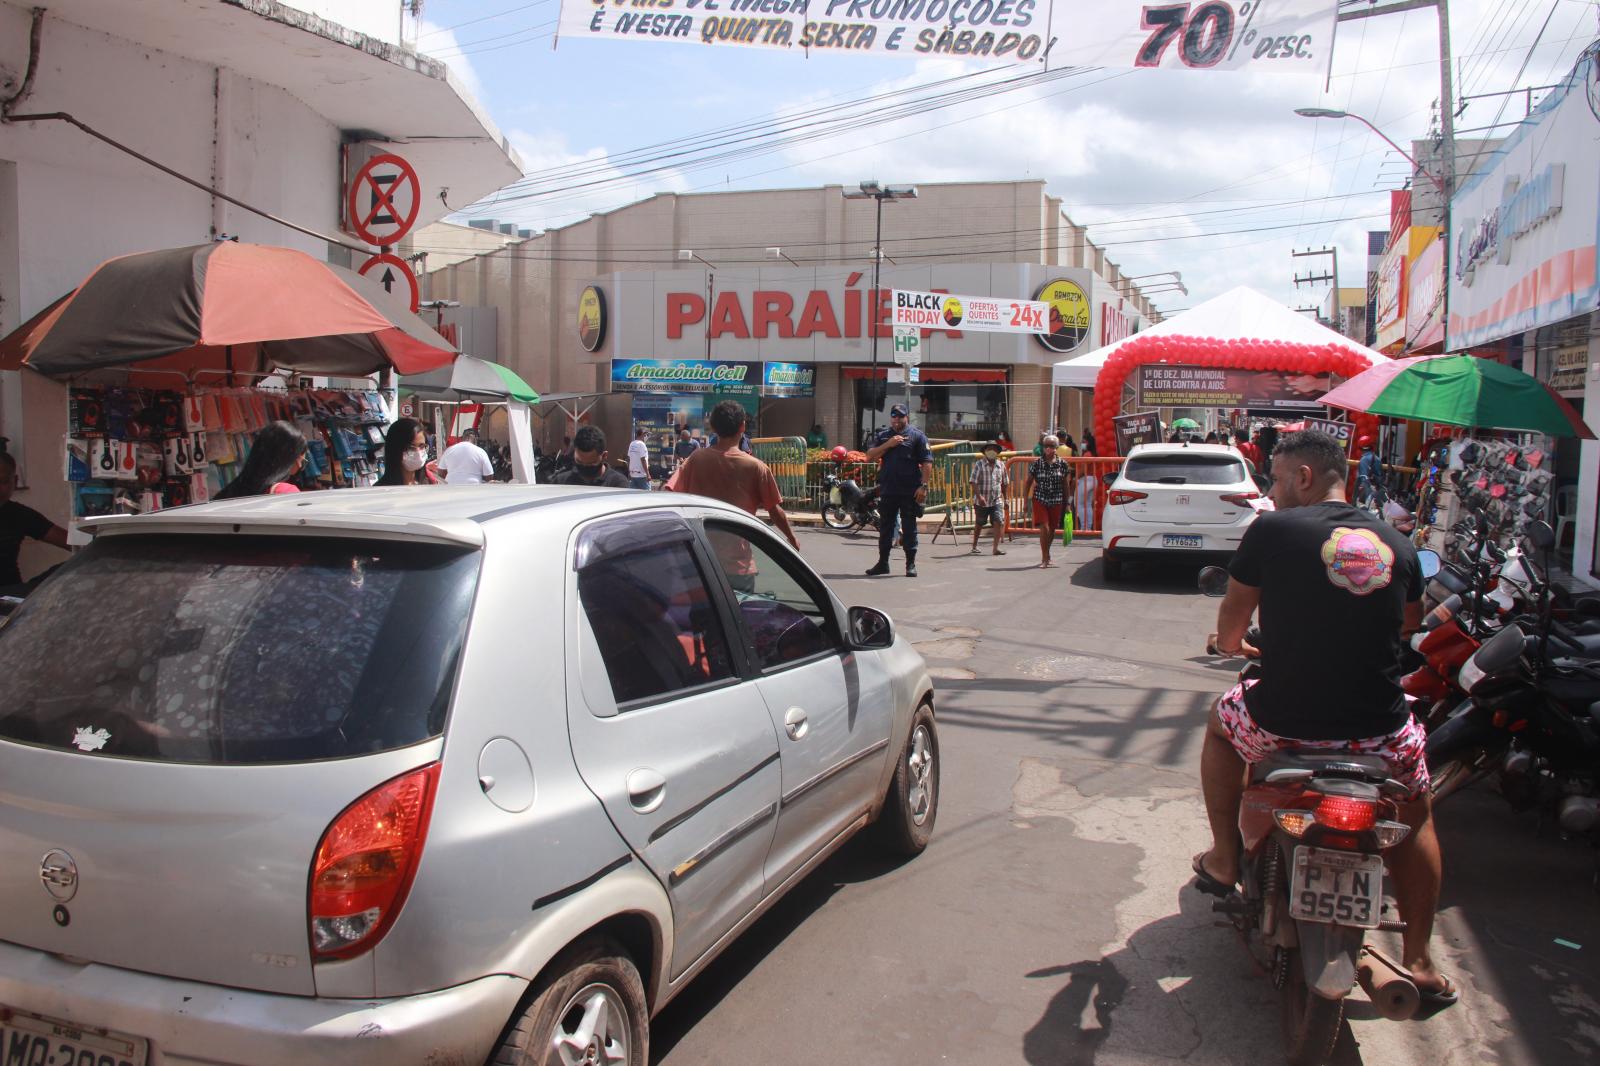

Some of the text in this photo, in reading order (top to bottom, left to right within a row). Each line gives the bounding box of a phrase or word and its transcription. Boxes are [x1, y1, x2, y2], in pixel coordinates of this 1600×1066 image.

[589, 4, 606, 32] É
[614, 12, 693, 37] NESTA
[799, 21, 878, 49] SEXTA
[885, 26, 906, 51] E
[1252, 35, 1313, 60] DESC.
[897, 292, 941, 311] BLACK
[969, 302, 998, 311] OFERTAS
[897, 309, 941, 325] FRIDAY
[968, 310, 999, 321] QUENTES
[895, 335, 919, 353] HP
[626, 363, 748, 381] Amazônia Cell
[1153, 370, 1162, 379] DE
[1180, 370, 1193, 379] DIA
[1194, 371, 1226, 380] MUNDIAL
[1143, 380, 1152, 389] DE
[1154, 380, 1171, 389] LUTA
[1172, 380, 1200, 389] CONTRA
[1201, 381, 1206, 389] A
[1311, 421, 1349, 439] AIDS
[1304, 866, 1370, 897] PTN
[1301, 891, 1372, 923] 9553
